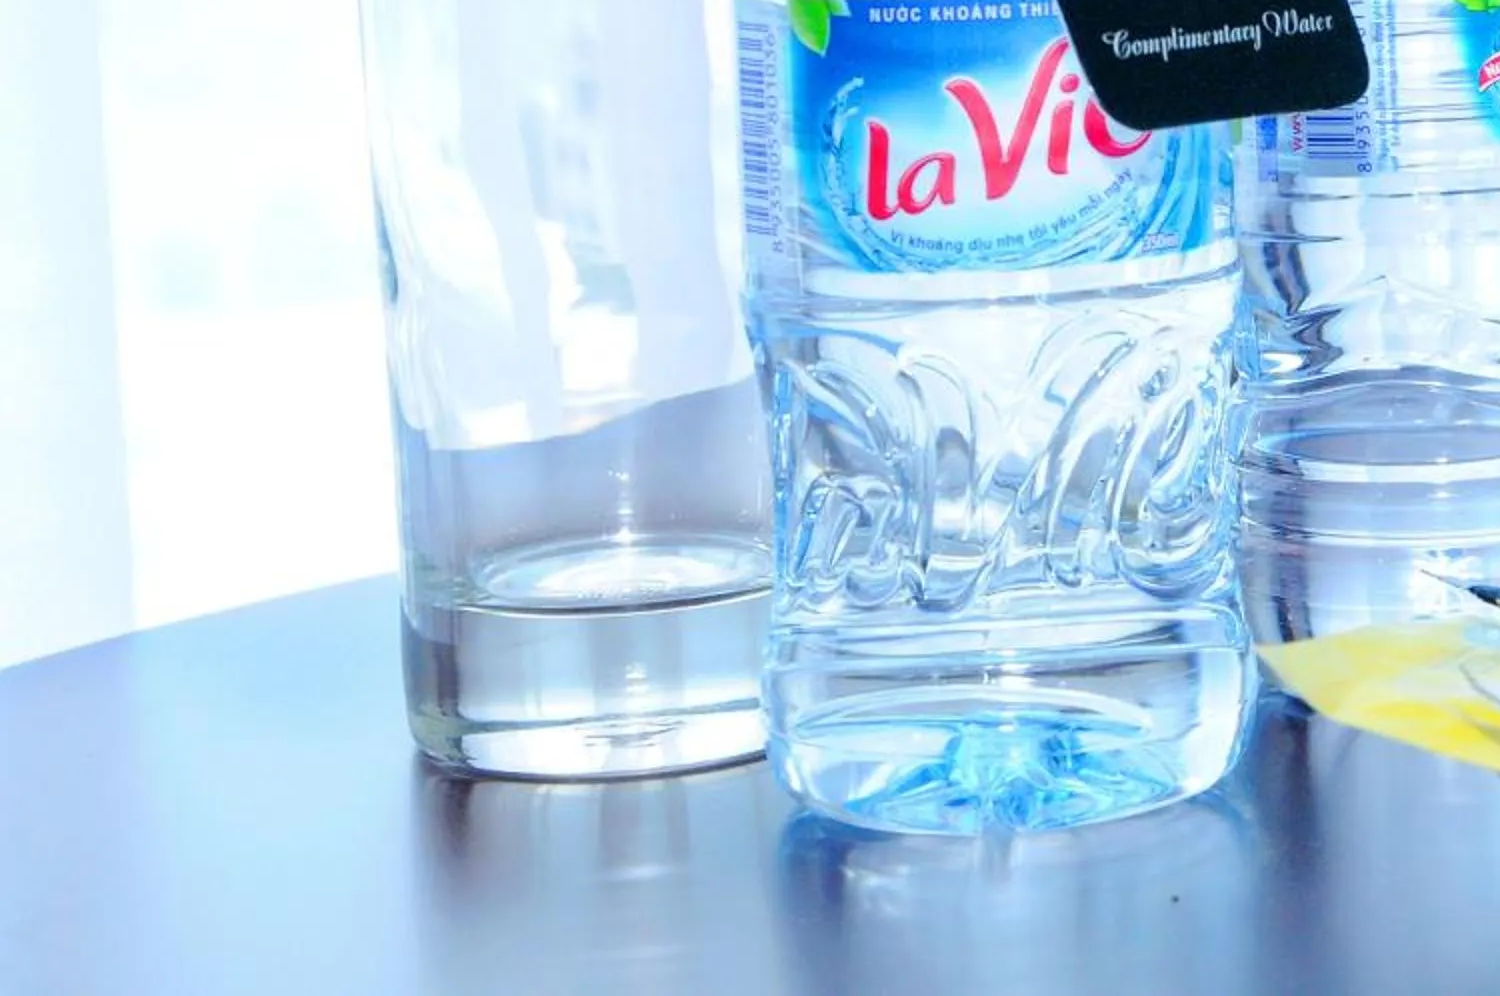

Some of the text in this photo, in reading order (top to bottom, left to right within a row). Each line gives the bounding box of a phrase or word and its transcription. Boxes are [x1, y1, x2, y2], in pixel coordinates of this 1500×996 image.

[1018, 2, 1060, 18] THI
[1101, 8, 1335, 63] Complimentary Water
